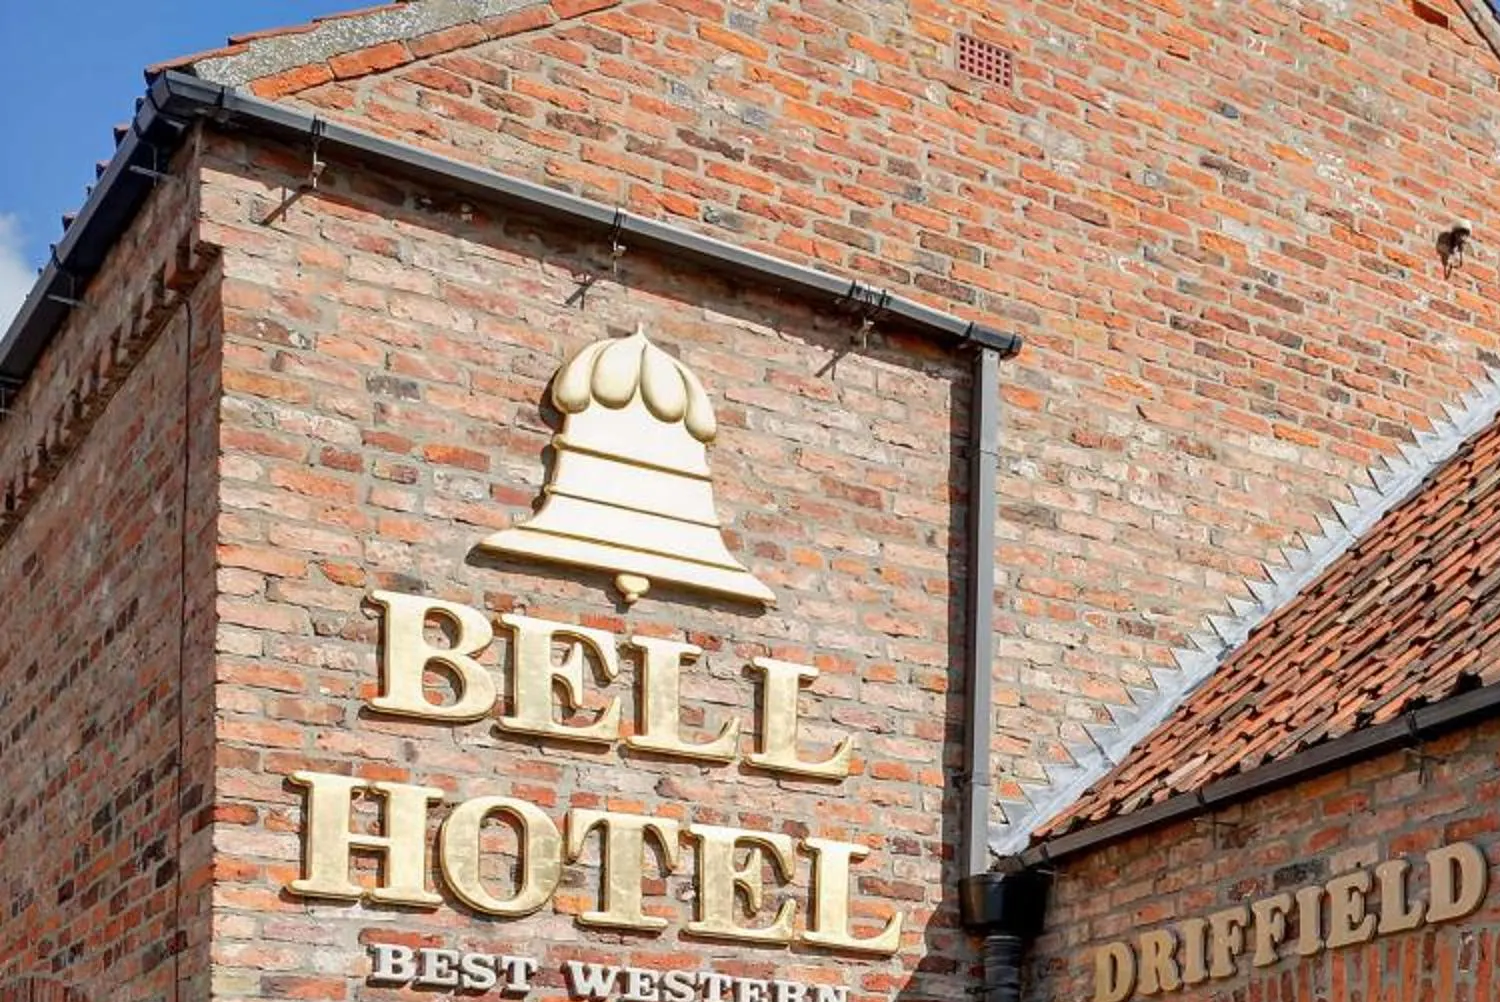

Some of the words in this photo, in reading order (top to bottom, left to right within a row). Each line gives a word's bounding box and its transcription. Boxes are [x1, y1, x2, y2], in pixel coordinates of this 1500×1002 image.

[360, 589, 854, 782] BELL
[283, 770, 904, 956] HOTEL
[369, 943, 538, 994] BEST
